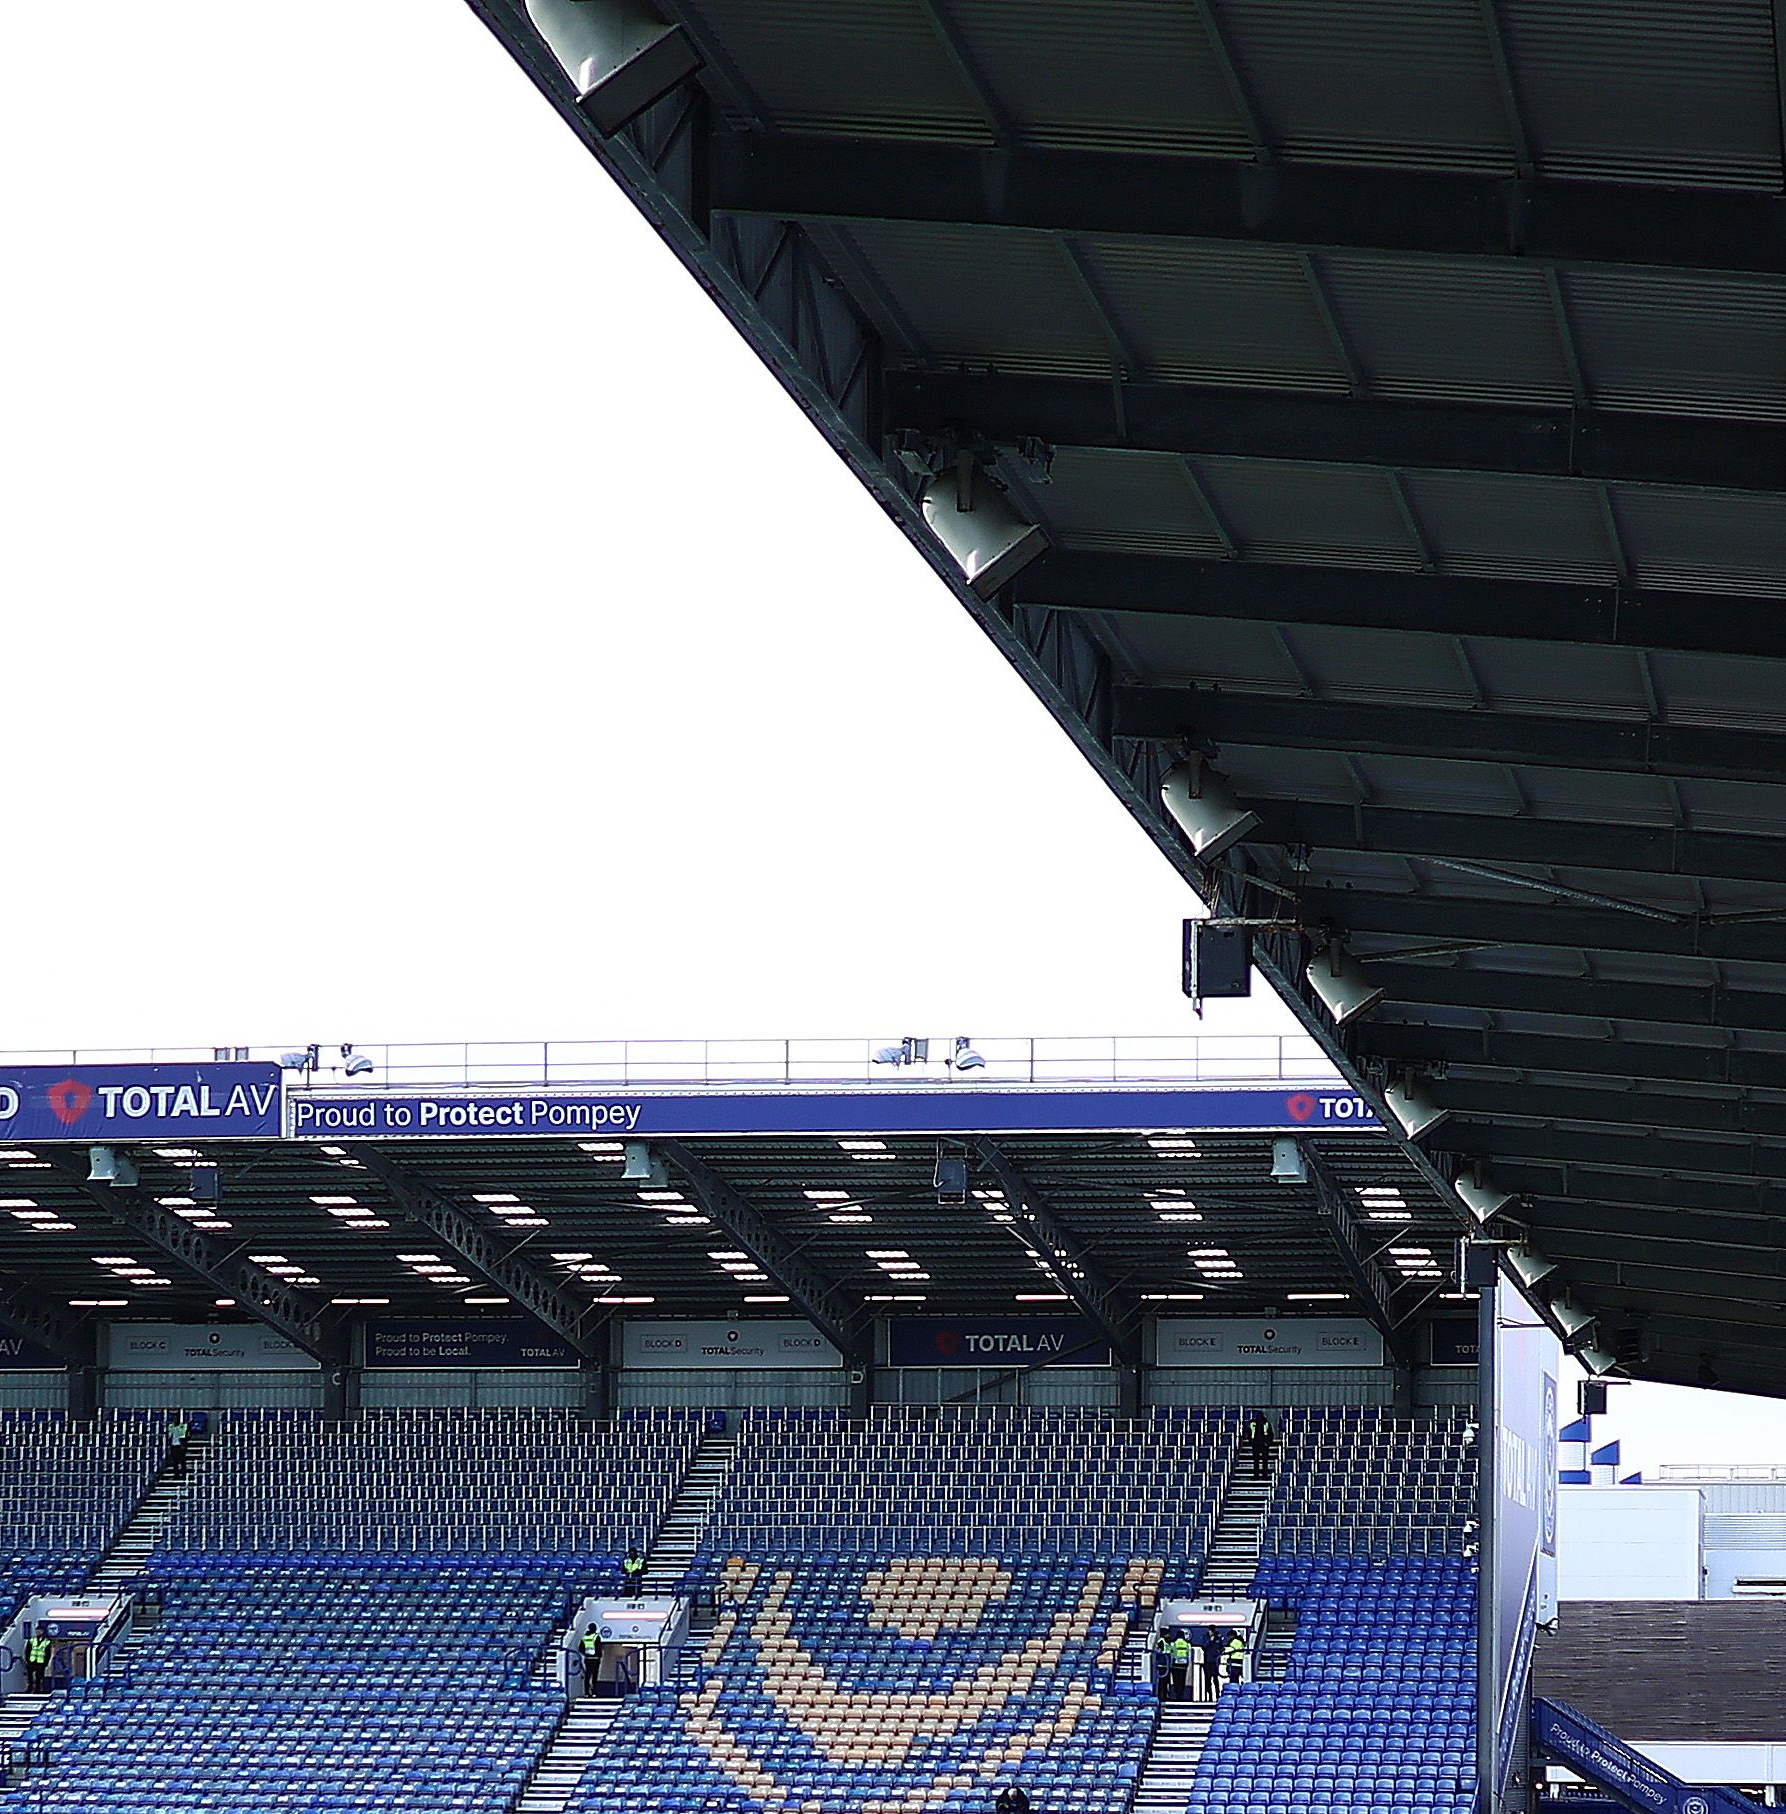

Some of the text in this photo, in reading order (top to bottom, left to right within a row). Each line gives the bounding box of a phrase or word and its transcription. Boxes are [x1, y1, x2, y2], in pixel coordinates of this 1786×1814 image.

[298, 1100, 641, 1130] Proud to Protect Pompey
[375, 1332, 406, 1343] Proud
[409, 1332, 420, 1342] to
[422, 1332, 462, 1343] Protect
[813, 1338, 821, 1347] D
[675, 1339, 682, 1348] D
[375, 1346, 472, 1357] Proud to be Local.
[1550, 1722, 1581, 1752] Proud
[1591, 1750, 1632, 1783] Protect
[1629, 1773, 1669, 1806] Pompey
